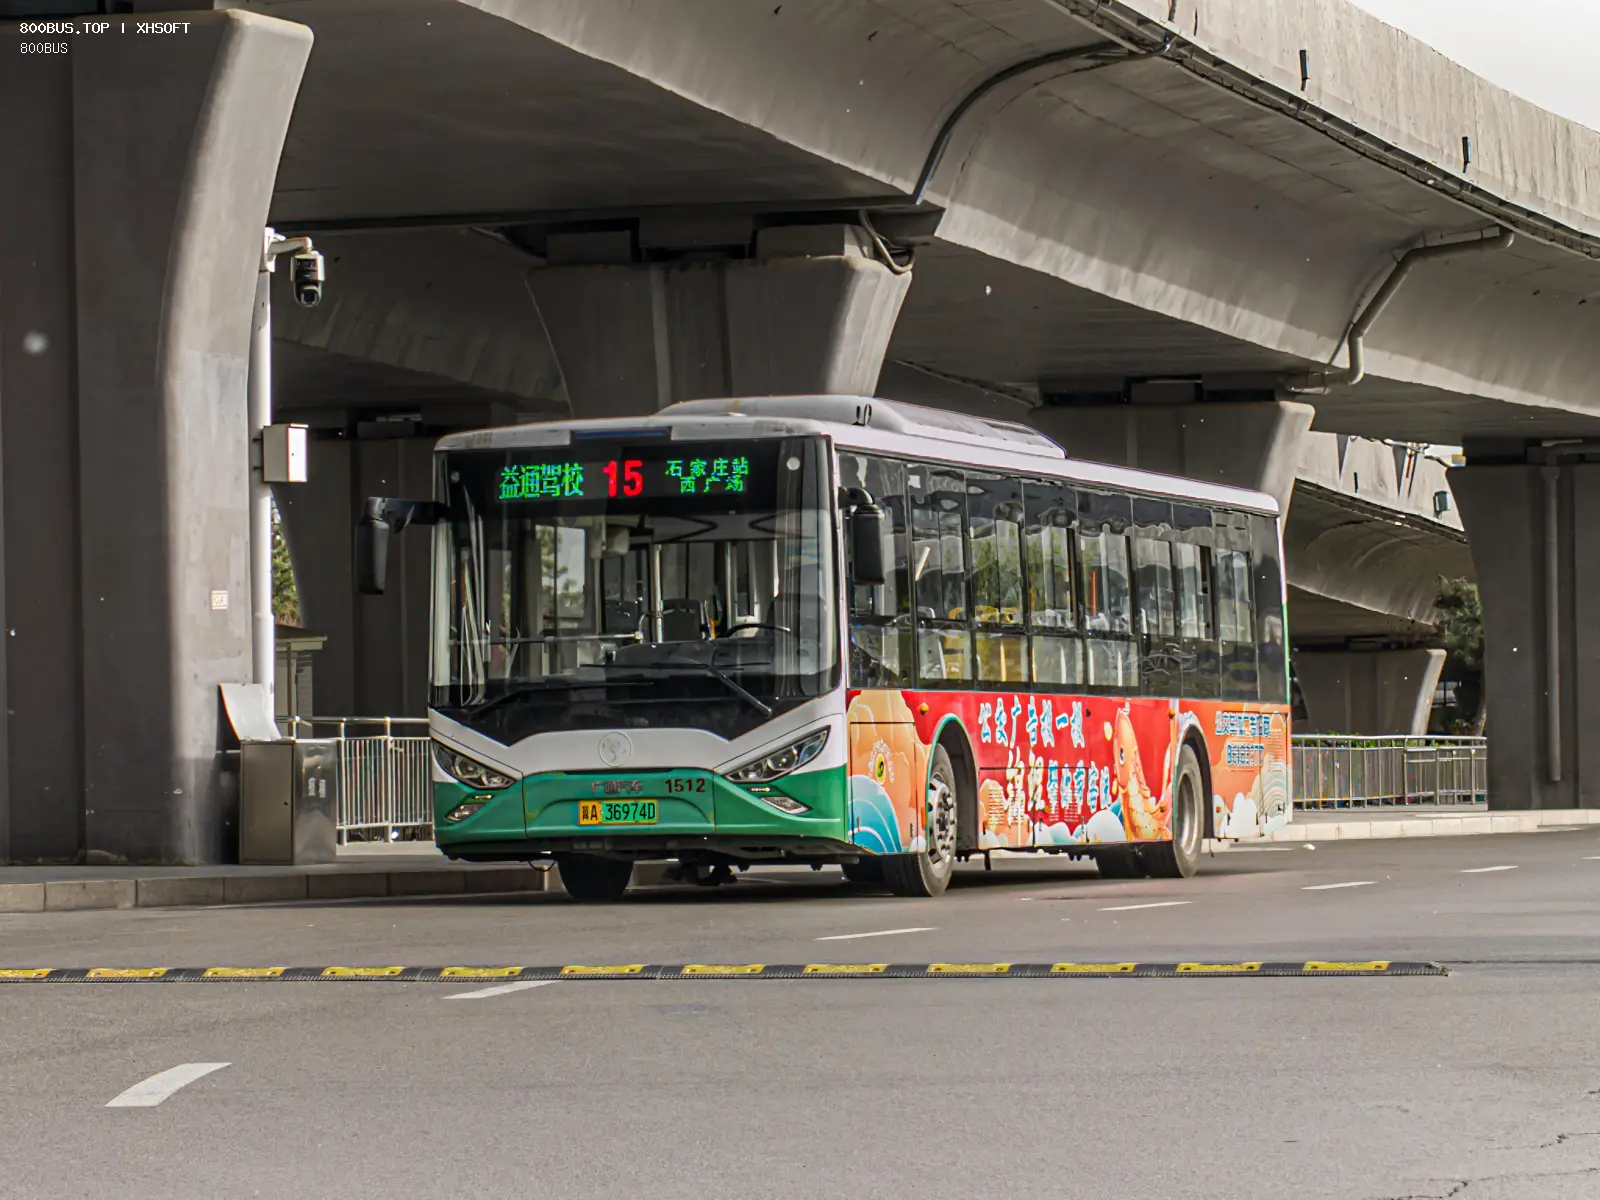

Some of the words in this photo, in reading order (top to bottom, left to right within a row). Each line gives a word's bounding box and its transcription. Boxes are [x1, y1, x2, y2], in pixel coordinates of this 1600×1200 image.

[665, 456, 748, 477] 石家庄站
[499, 462, 585, 499] 益通驾校
[602, 460, 643, 497] 15
[680, 475, 744, 493] 西广场
[665, 777, 706, 793] 1512
